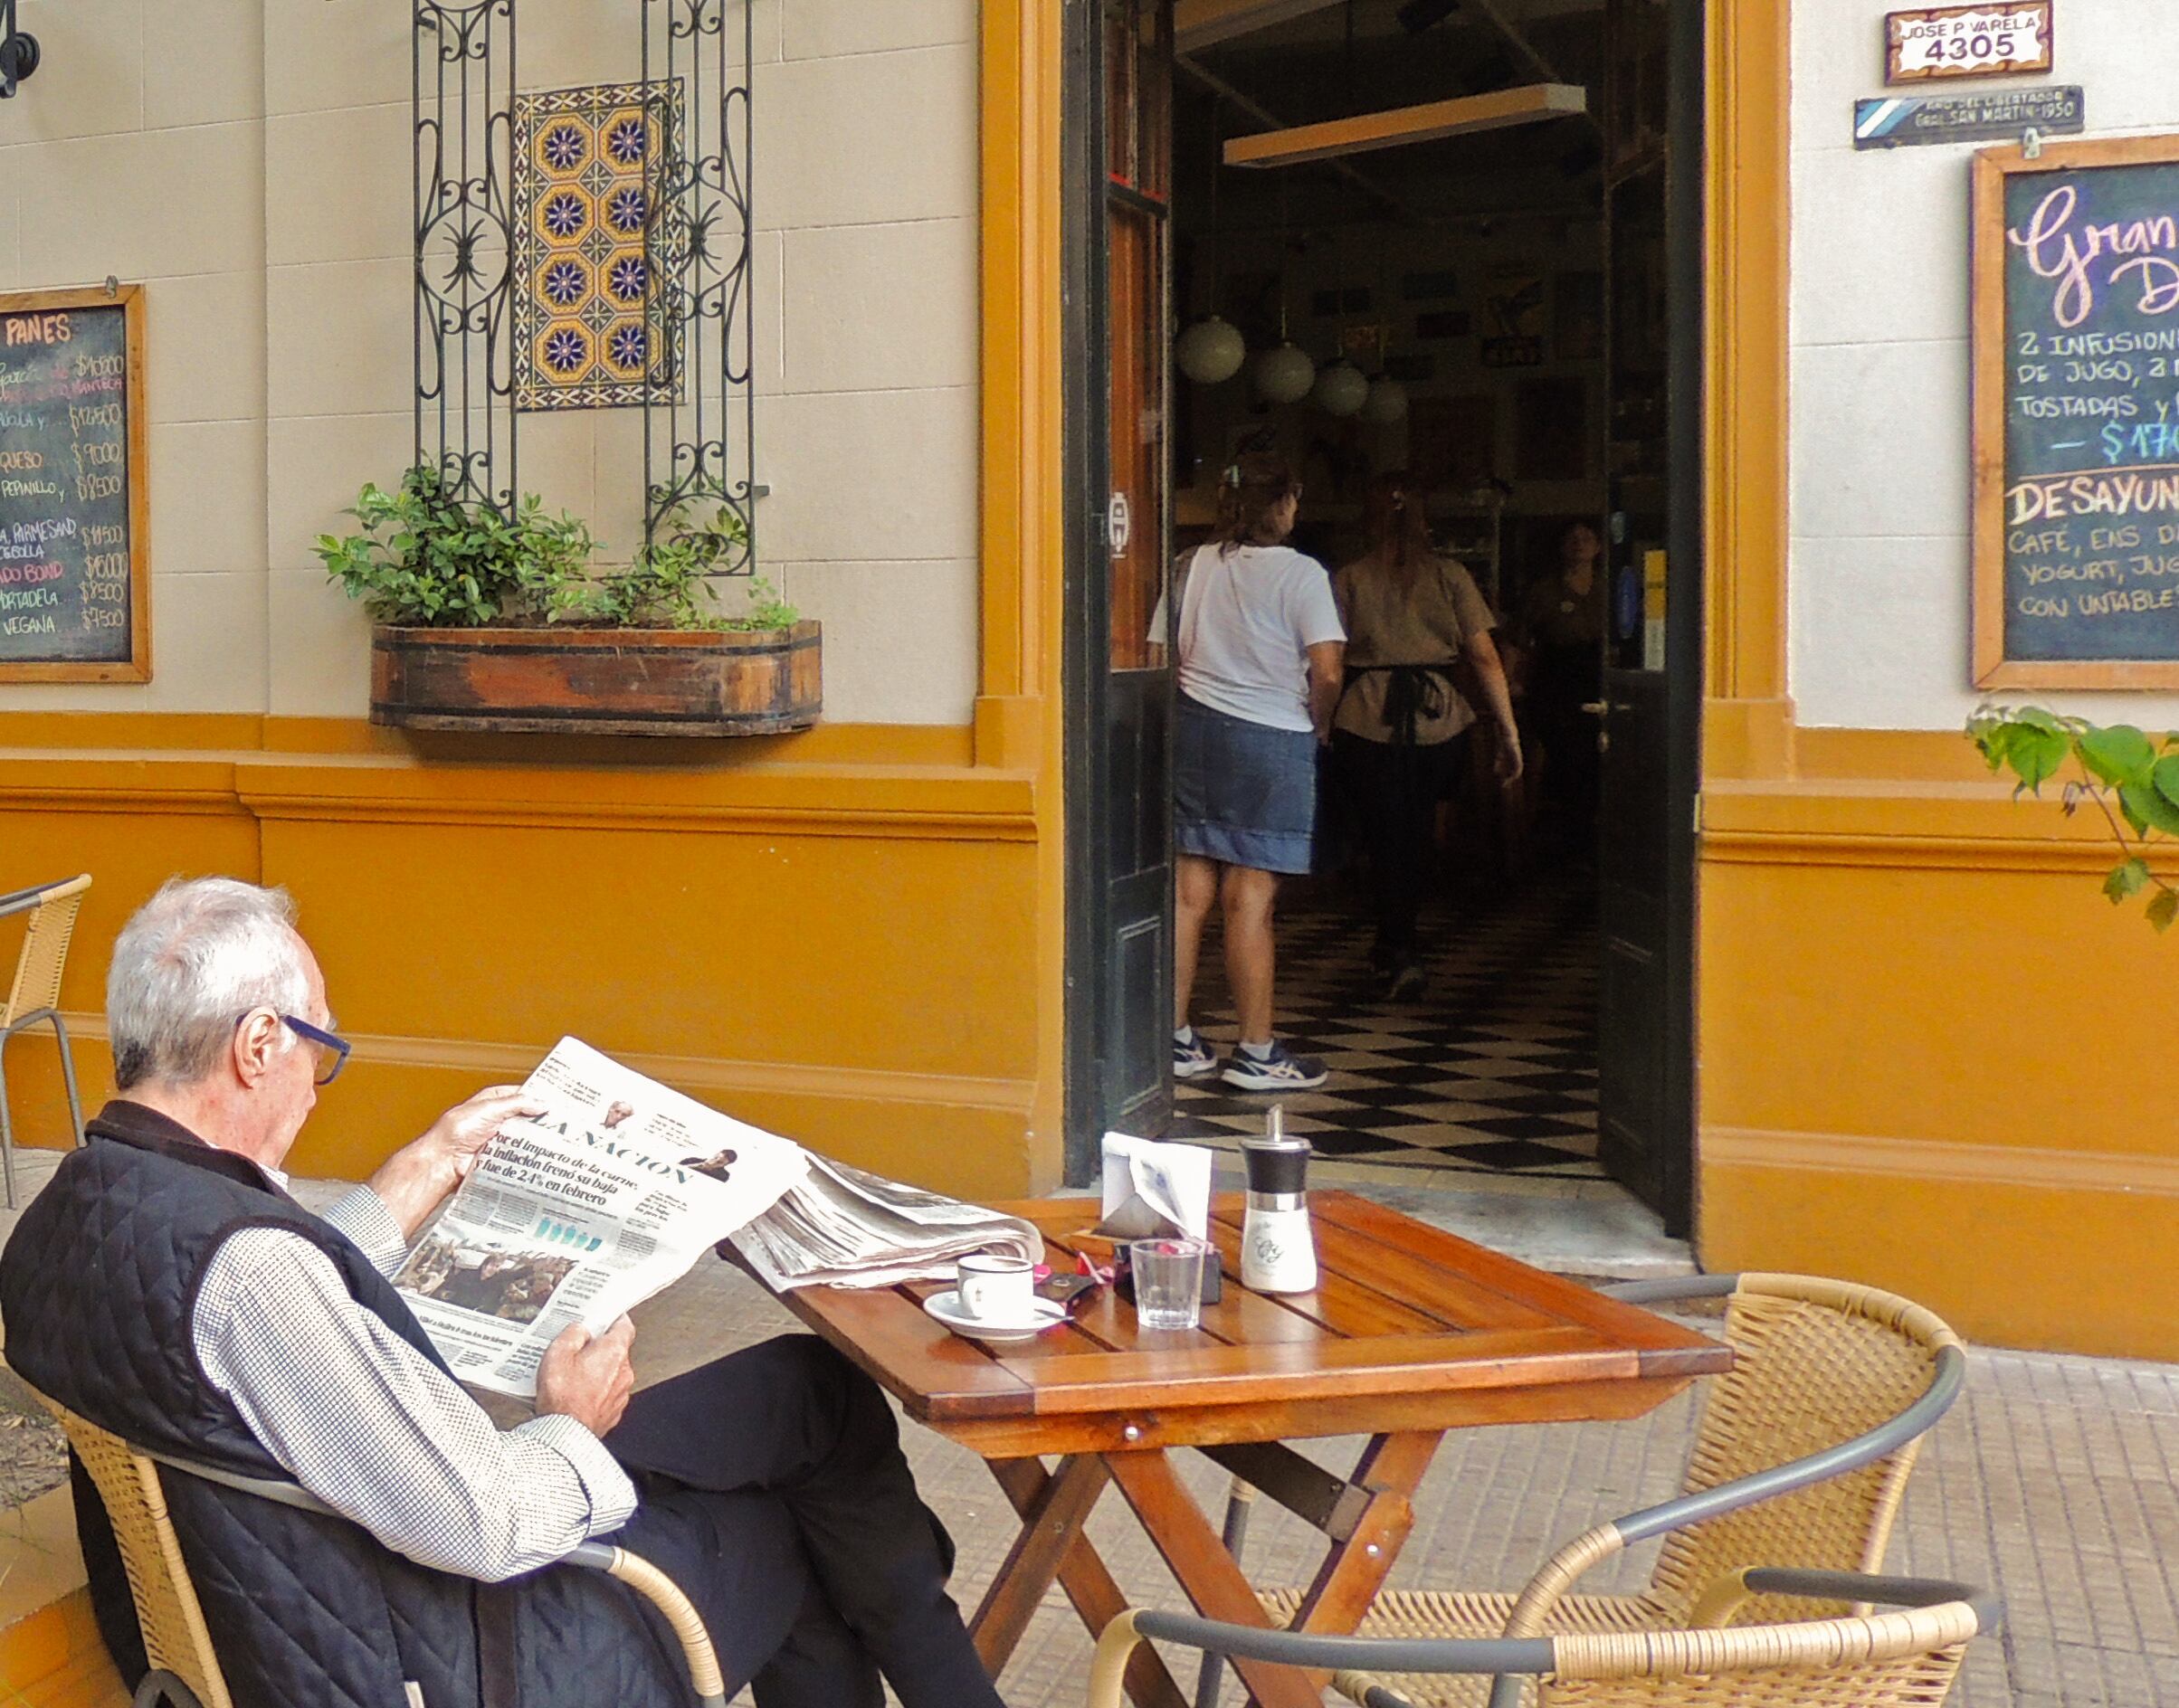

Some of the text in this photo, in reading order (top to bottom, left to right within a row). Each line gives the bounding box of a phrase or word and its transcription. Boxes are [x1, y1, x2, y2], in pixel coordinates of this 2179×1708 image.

[1902, 17, 2036, 40] JOSE P VARELA
[1925, 34, 2016, 62] 4305
[2007, 185, 2176, 328] Gran
[5, 313, 71, 347] PANES
[2019, 328, 2179, 356] 2 INFUSION
[2016, 364, 2048, 384] DE
[2015, 394, 2139, 419] TOSTADAS
[2019, 596, 2069, 617] CON
[4, 615, 56, 635] VEGANA
[530, 1112, 567, 1135] LA
[510, 1137, 525, 1149] el
[522, 1140, 571, 1164] impacto
[572, 1155, 587, 1170] de
[601, 1167, 638, 1191] carne,
[542, 1160, 576, 1181] frenó
[575, 1172, 591, 1186] su
[592, 1173, 619, 1196] baja
[482, 1159, 502, 1175] fue
[501, 1165, 517, 1179] de
[545, 1176, 561, 1192] en
[559, 1180, 607, 1206] febrero
